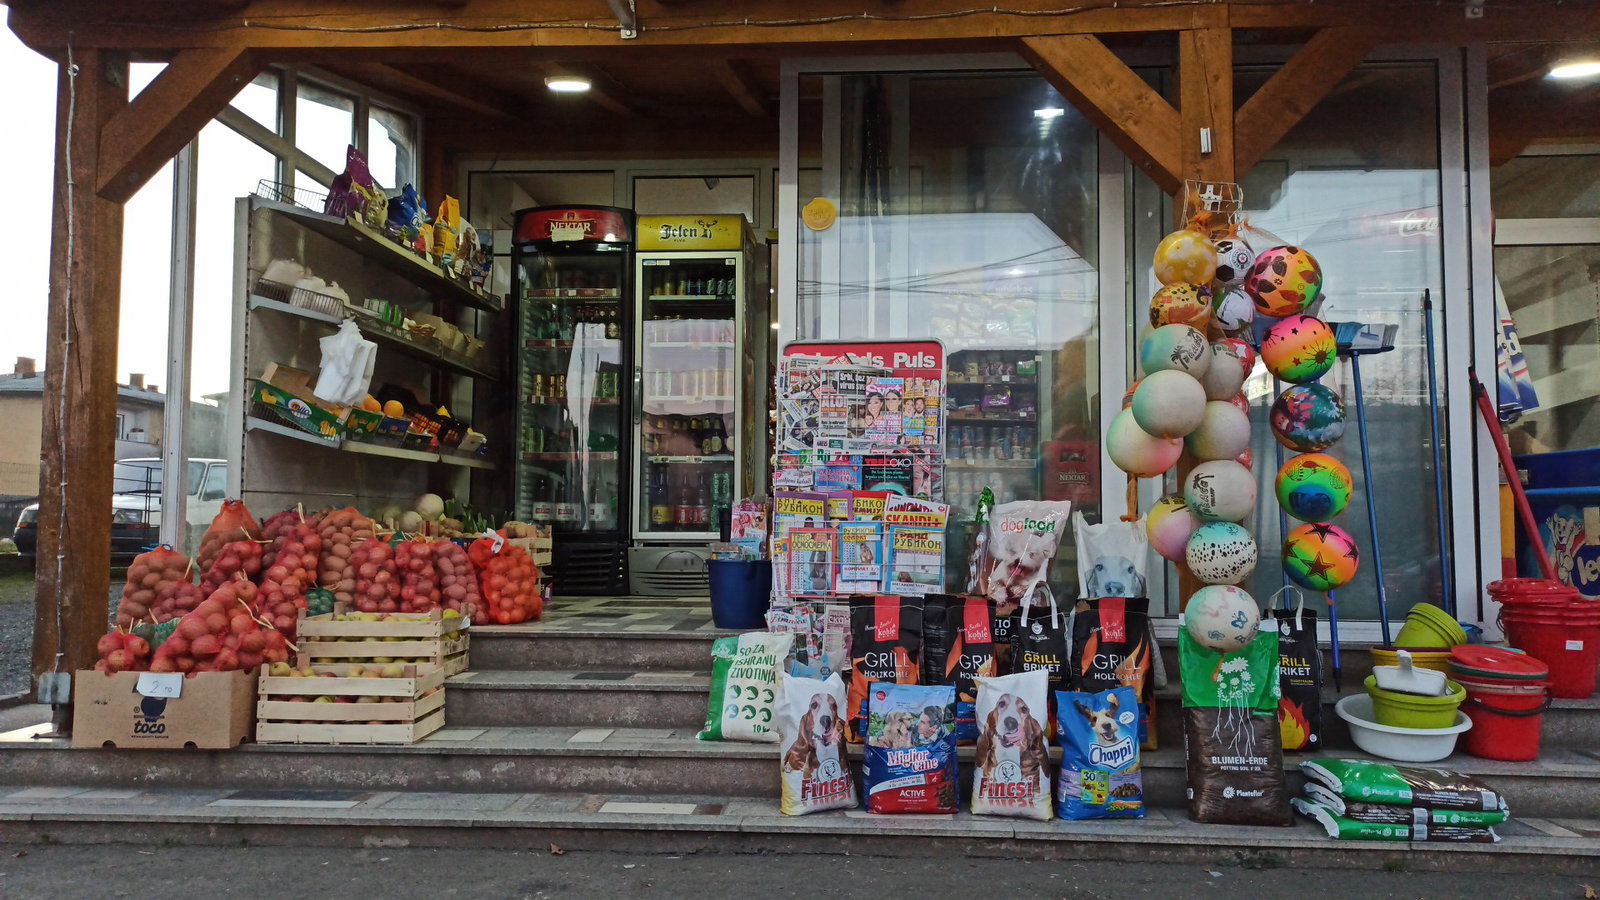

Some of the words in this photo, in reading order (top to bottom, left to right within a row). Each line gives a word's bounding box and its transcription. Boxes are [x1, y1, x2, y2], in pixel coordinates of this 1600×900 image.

[550, 222, 591, 232] NEKTAR
[660, 224, 698, 240] Jelen
[893, 352, 936, 368] Puls
[821, 395, 847, 408] ALO!
[777, 502, 823, 514] РУБИКОН
[1001, 517, 1056, 534] dogfood
[894, 539, 942, 549] РУБИКОН
[877, 627, 896, 637] kohle
[967, 628, 989, 638] kohle
[1104, 628, 1124, 638] kohle
[739, 647, 752, 657] SO
[752, 644, 765, 654] ZA
[734, 654, 777, 667] ISHRANU
[864, 652, 910, 668] GRILL
[1024, 653, 1060, 664] GRILL
[1093, 654, 1142, 670] GRILL
[1280, 657, 1310, 667] RILL
[1023, 663, 1061, 673] BRIKET
[1280, 667, 1311, 676] RIKET
[864, 670, 909, 679] HOLZKOHLE
[1094, 672, 1142, 681] HOLZKOHLE
[133, 720, 166, 734] toco
[887, 749, 929, 768] Miglior
[1091, 742, 1132, 765] Chappi
[912, 758, 939, 772] cane
[1211, 756, 1268, 765] BLUMEN-ERDE
[1083, 772, 1096, 781] 30
[801, 770, 850, 799] Fincsi
[979, 775, 1034, 797] Fincsi
[900, 789, 926, 797] ACTIVE
